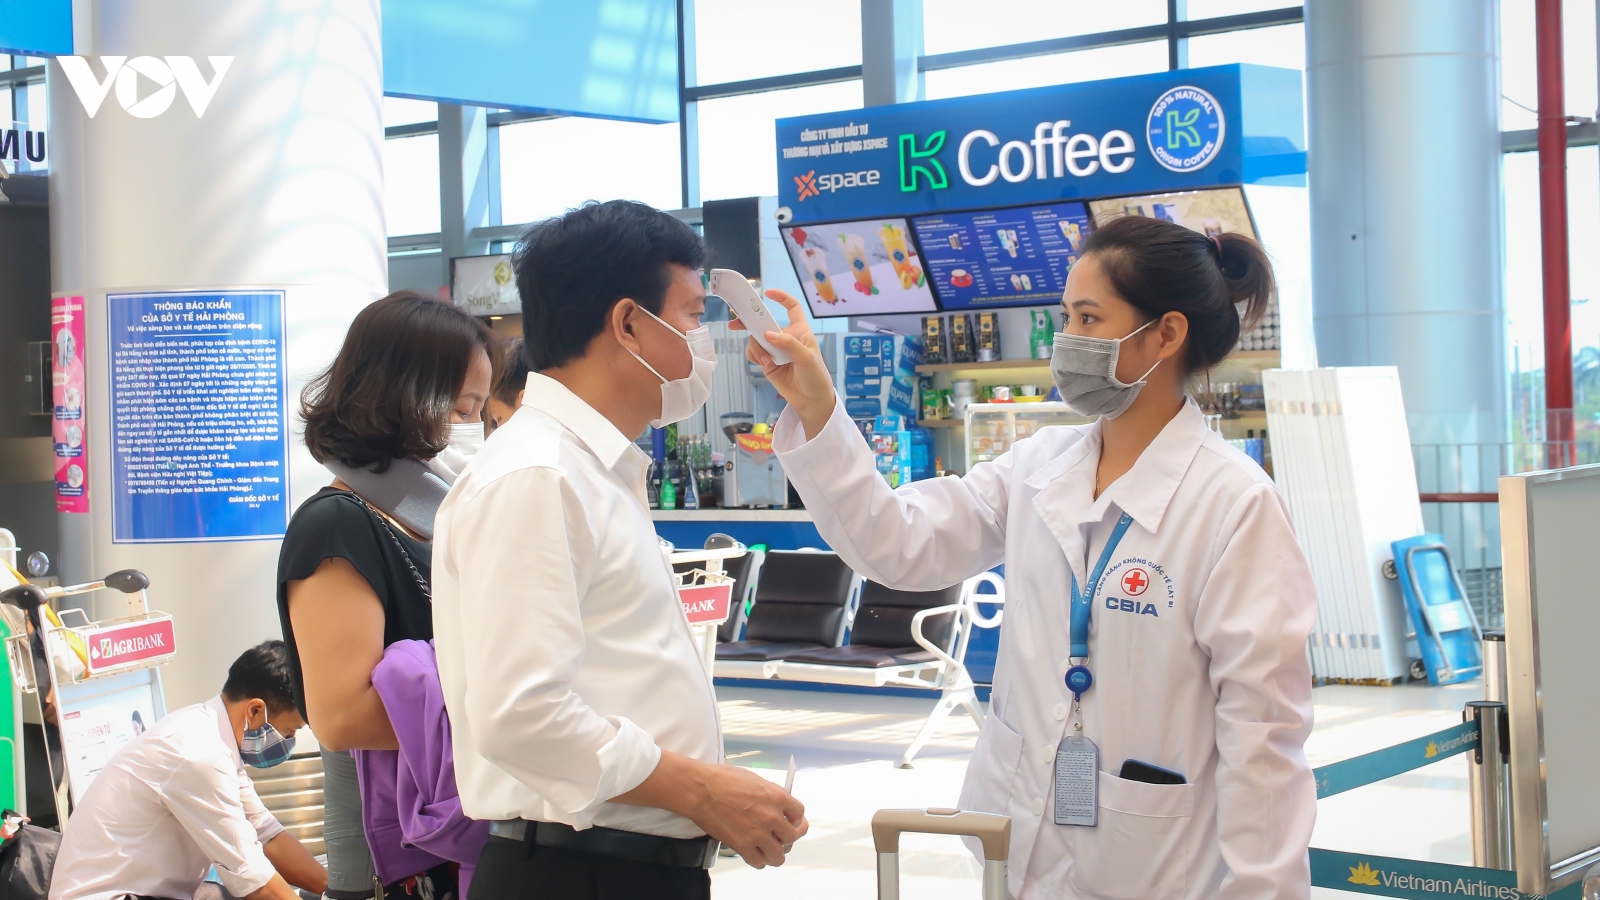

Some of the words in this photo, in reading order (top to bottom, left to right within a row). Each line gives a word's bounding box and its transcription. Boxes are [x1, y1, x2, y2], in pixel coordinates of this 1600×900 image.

[1154, 94, 1175, 118] 100%
[1175, 90, 1213, 115] NATURAL
[863, 137, 888, 151] XSPACE
[958, 120, 1136, 187] Coffee
[1156, 146, 1182, 167] ORIGIN
[1184, 141, 1215, 167] COFFEE
[154, 301, 183, 311] THÔNG
[186, 301, 204, 310] BÁO
[206, 299, 231, 309] KHẨN
[142, 313, 159, 322] CỦA
[161, 311, 173, 322] SỞ
[182, 311, 193, 321] TẾ
[196, 312, 211, 321] HẢI
[213, 311, 245, 321] PHÒNG
[862, 339, 872, 347] 28
[883, 359, 892, 367] 28
[1122, 557, 1147, 565] KHÔNG
[1105, 596, 1159, 618] CBIA
[112, 632, 165, 657] AGRIBANK
[1437, 736, 1461, 754] Vietnam
[1381, 871, 1454, 894] Vietnam
[1454, 880, 1520, 900] Airlines
